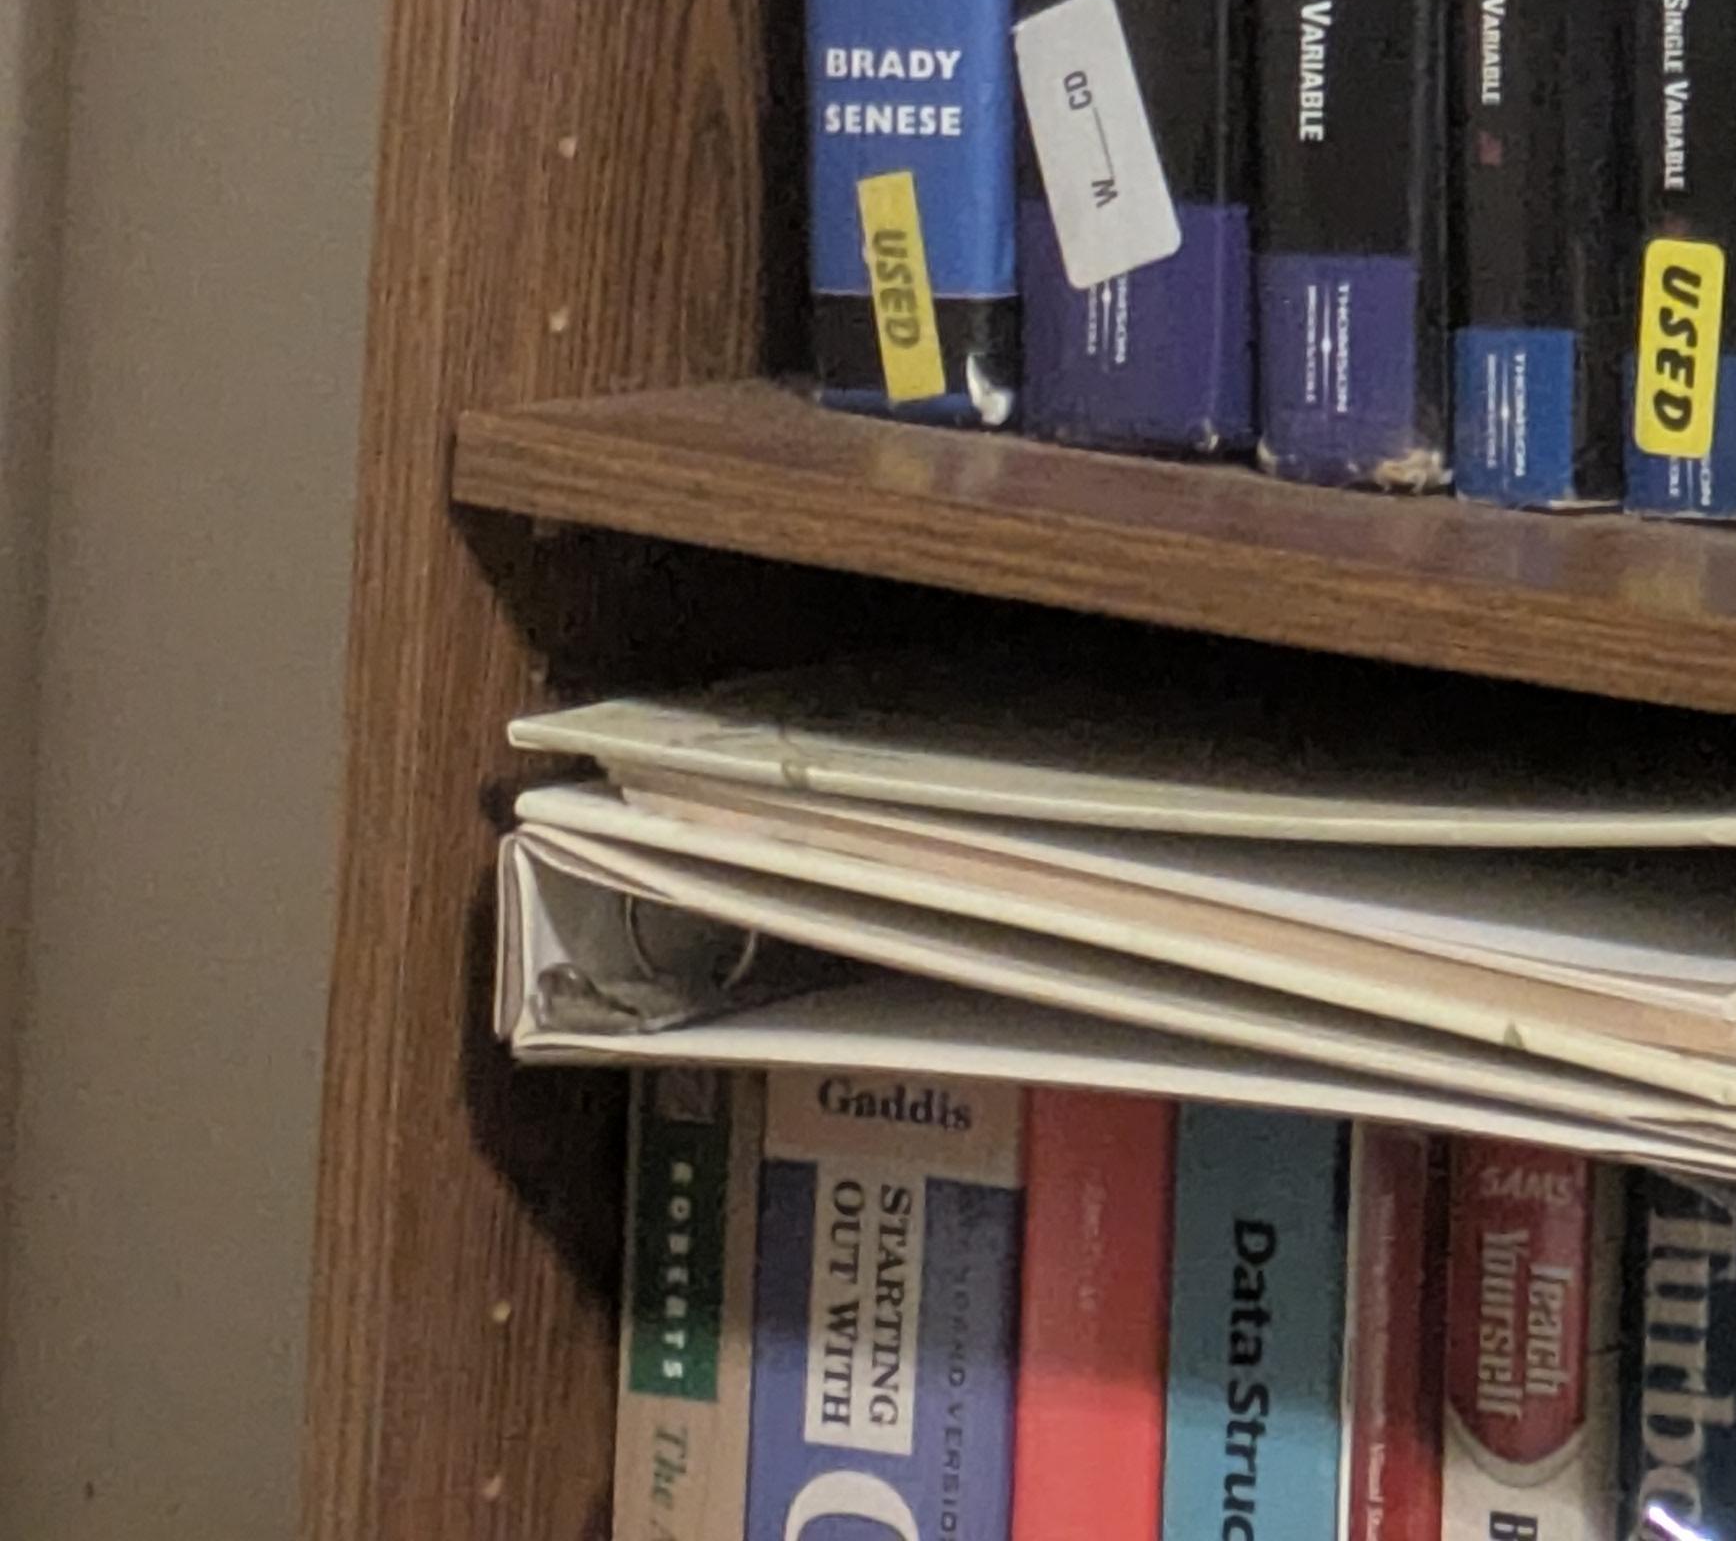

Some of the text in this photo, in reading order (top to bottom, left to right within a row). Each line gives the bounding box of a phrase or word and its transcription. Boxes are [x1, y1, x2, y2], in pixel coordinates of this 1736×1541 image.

[825, 49, 963, 81] BRADY
[825, 106, 963, 138] SENESE
[1300, 0, 1334, 143] VARIABLE
[1663, 80, 1691, 191] VARIABLE
[870, 227, 923, 351] USED
[1654, 264, 1704, 433] USED
[817, 1076, 974, 1133] Gaddis
[821, 1179, 866, 1429] OUT WITH
[870, 1182, 912, 1428] STARTING
[1229, 1217, 1278, 1368] Data
[1477, 1227, 1530, 1421] Yourself
[1525, 1262, 1573, 1397] Teach
